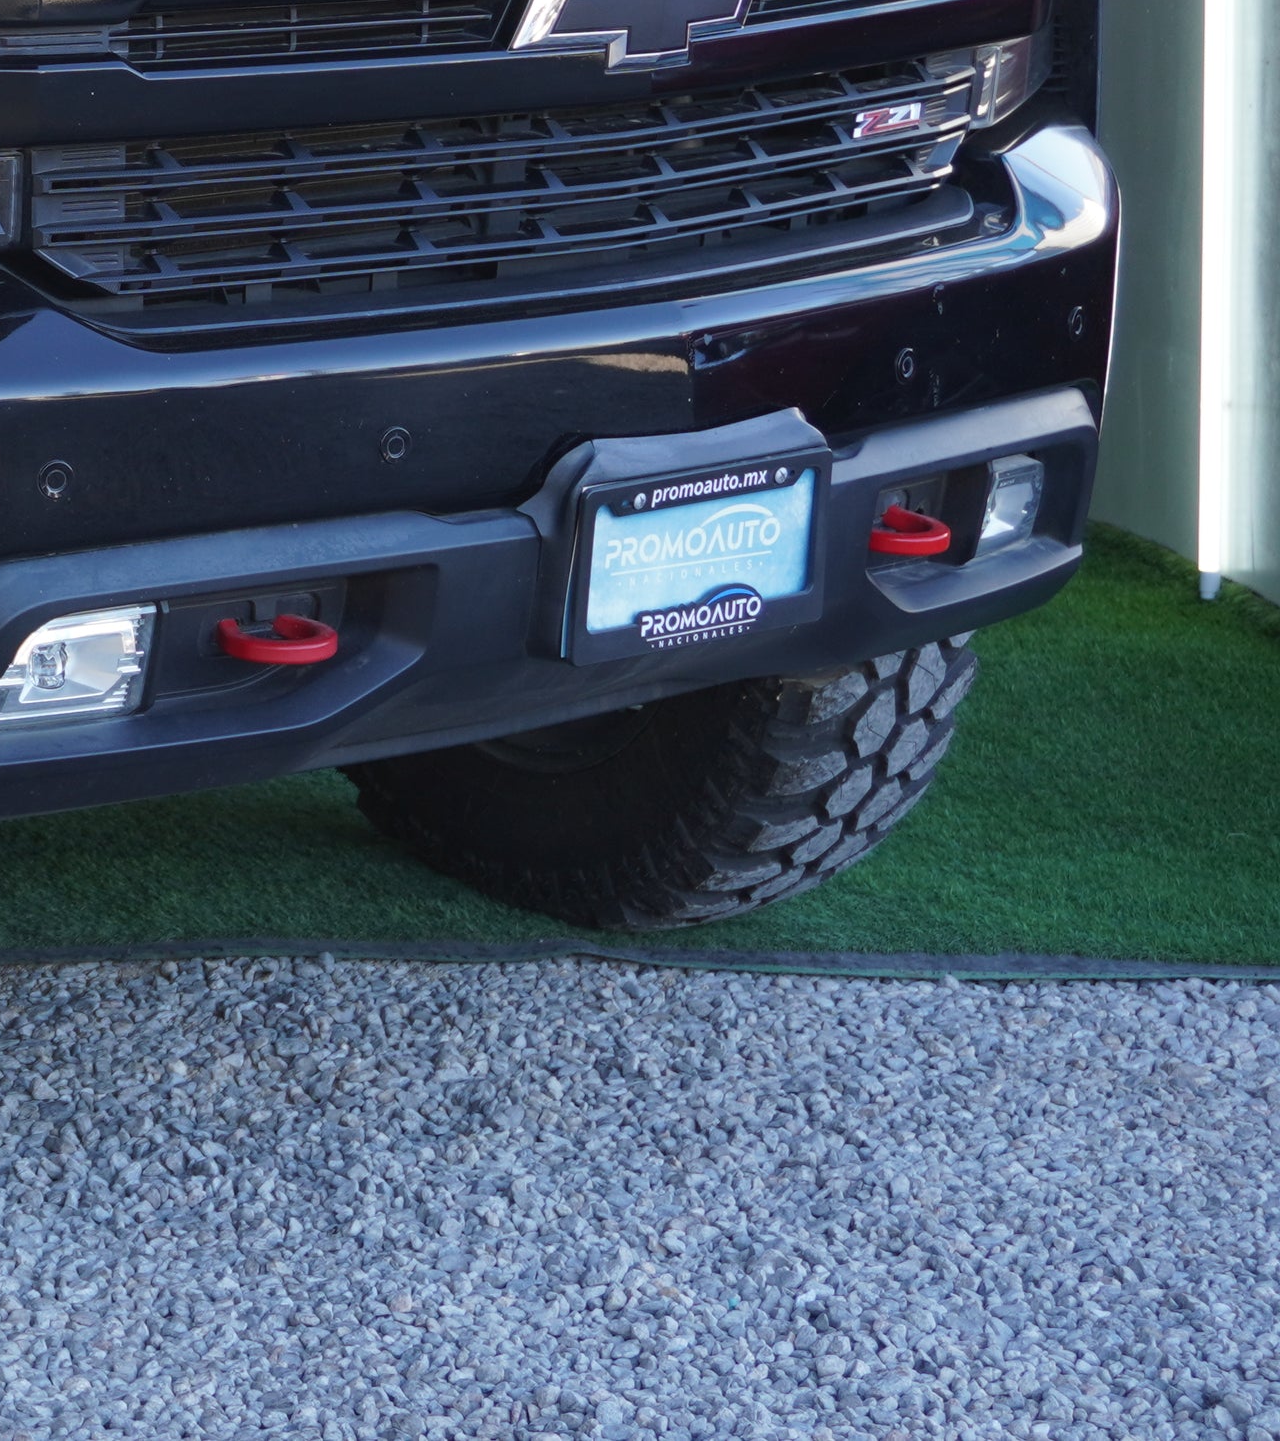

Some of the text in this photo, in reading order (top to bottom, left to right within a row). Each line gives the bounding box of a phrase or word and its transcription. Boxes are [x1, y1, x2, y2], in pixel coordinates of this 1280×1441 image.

[852, 102, 921, 138] Z71
[651, 469, 768, 507] promoauto.mx
[605, 517, 781, 569] PROMOAUTO
[627, 559, 754, 588] NACIONALES
[640, 596, 761, 637] PROMOAUTO
[658, 624, 744, 649] NACIONALES
